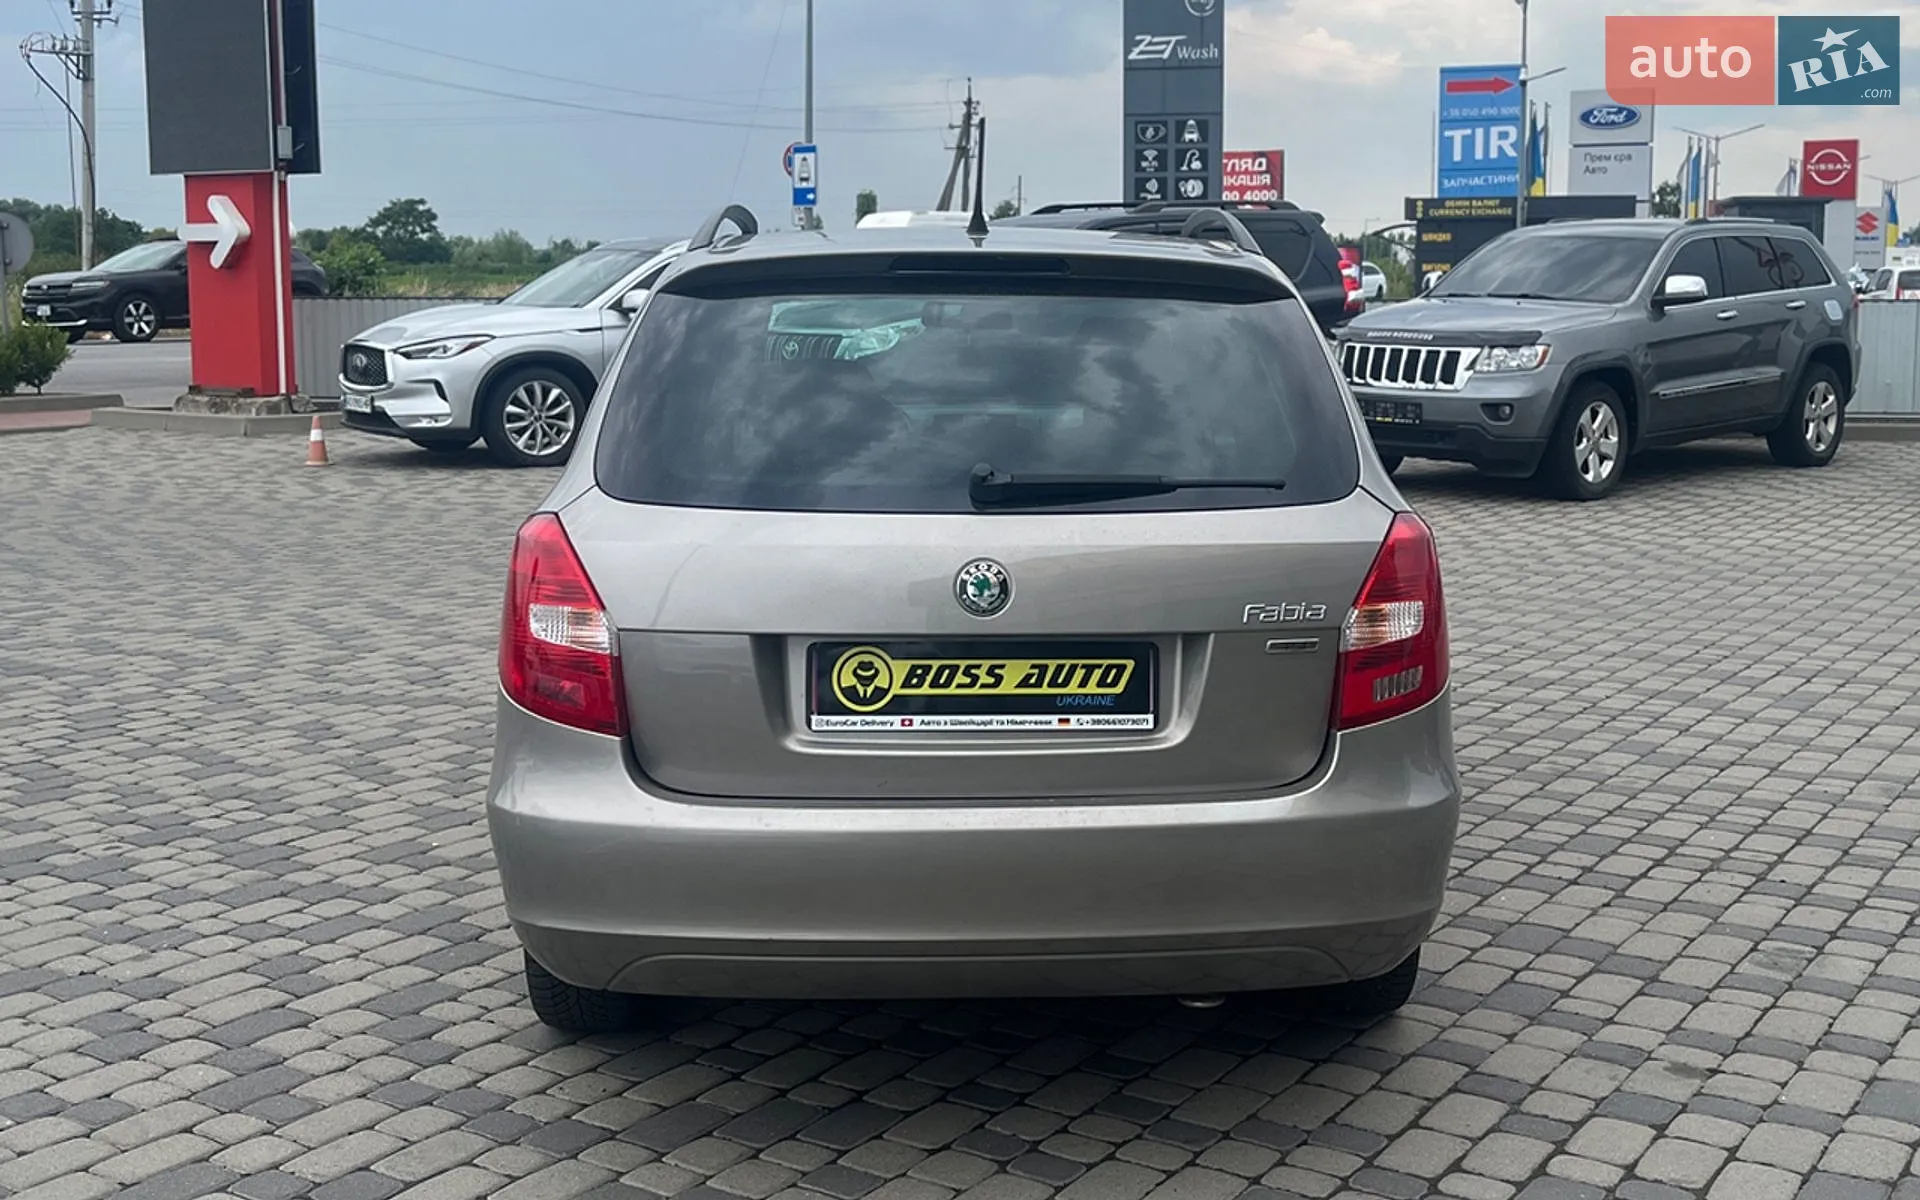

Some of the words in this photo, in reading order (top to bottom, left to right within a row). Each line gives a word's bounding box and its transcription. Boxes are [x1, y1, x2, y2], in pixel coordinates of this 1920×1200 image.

[1128, 35, 1187, 60] ZET
[1177, 43, 1218, 60] Wash
[1590, 107, 1628, 124] Ford
[1444, 125, 1518, 162] TIR
[1584, 165, 1608, 175] Авто
[1807, 163, 1851, 171] NISSAN
[1243, 189, 1278, 201] 4000
[1428, 208, 1469, 217] CURRENCY
[1472, 207, 1512, 216] EXCHANGE
[1242, 602, 1327, 623] Fabia
[900, 663, 1006, 690] BOSS
[1014, 663, 1128, 689] AUTO
[1056, 695, 1115, 707] UKRAINE
[859, 717, 894, 728] Delivery
